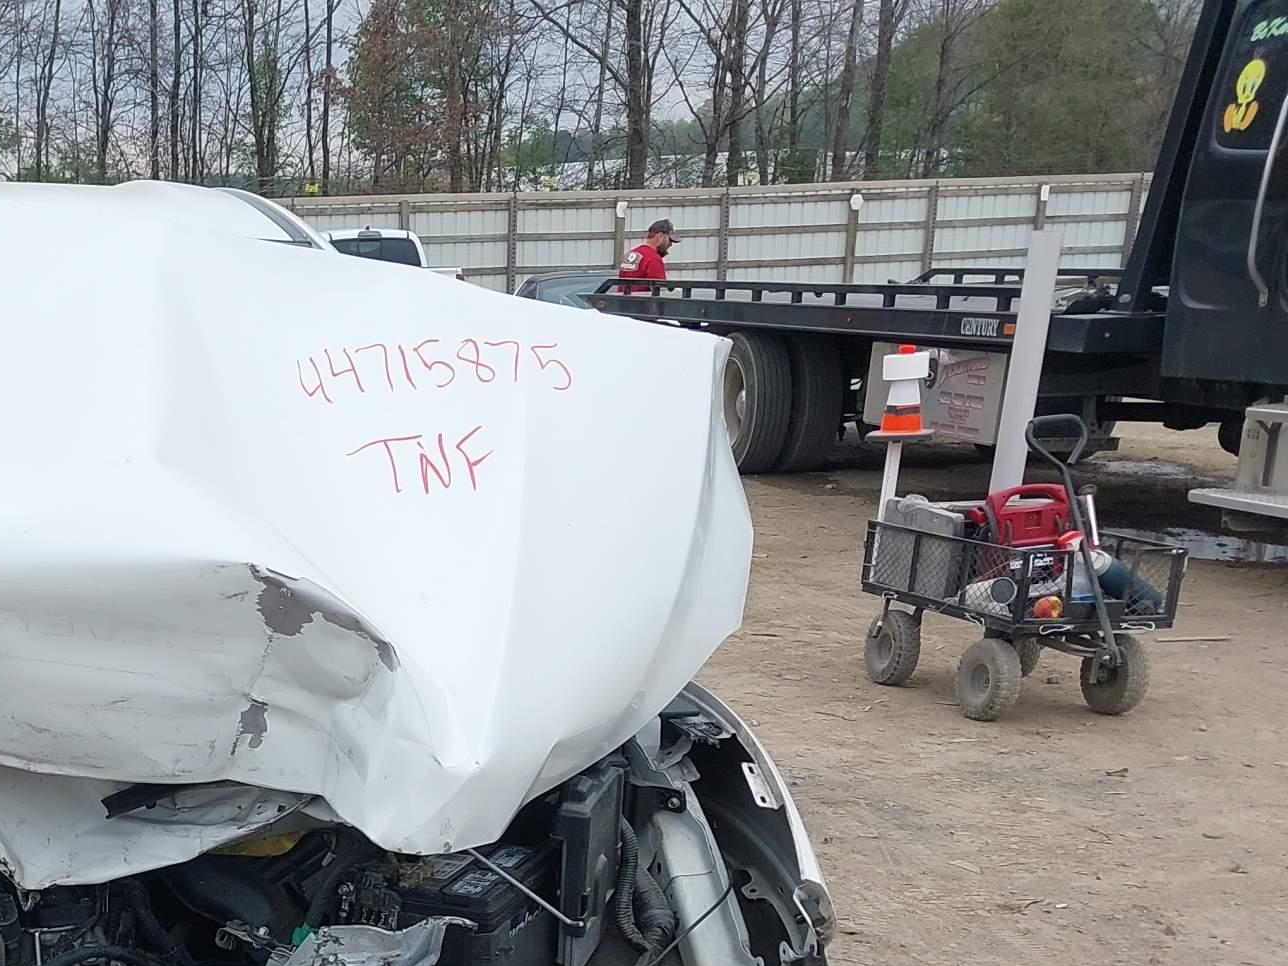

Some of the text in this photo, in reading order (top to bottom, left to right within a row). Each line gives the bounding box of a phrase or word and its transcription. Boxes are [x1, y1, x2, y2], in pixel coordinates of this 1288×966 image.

[960, 317, 1001, 337] CENTURY
[297, 338, 572, 404] 44715875
[345, 425, 494, 495] TNF
